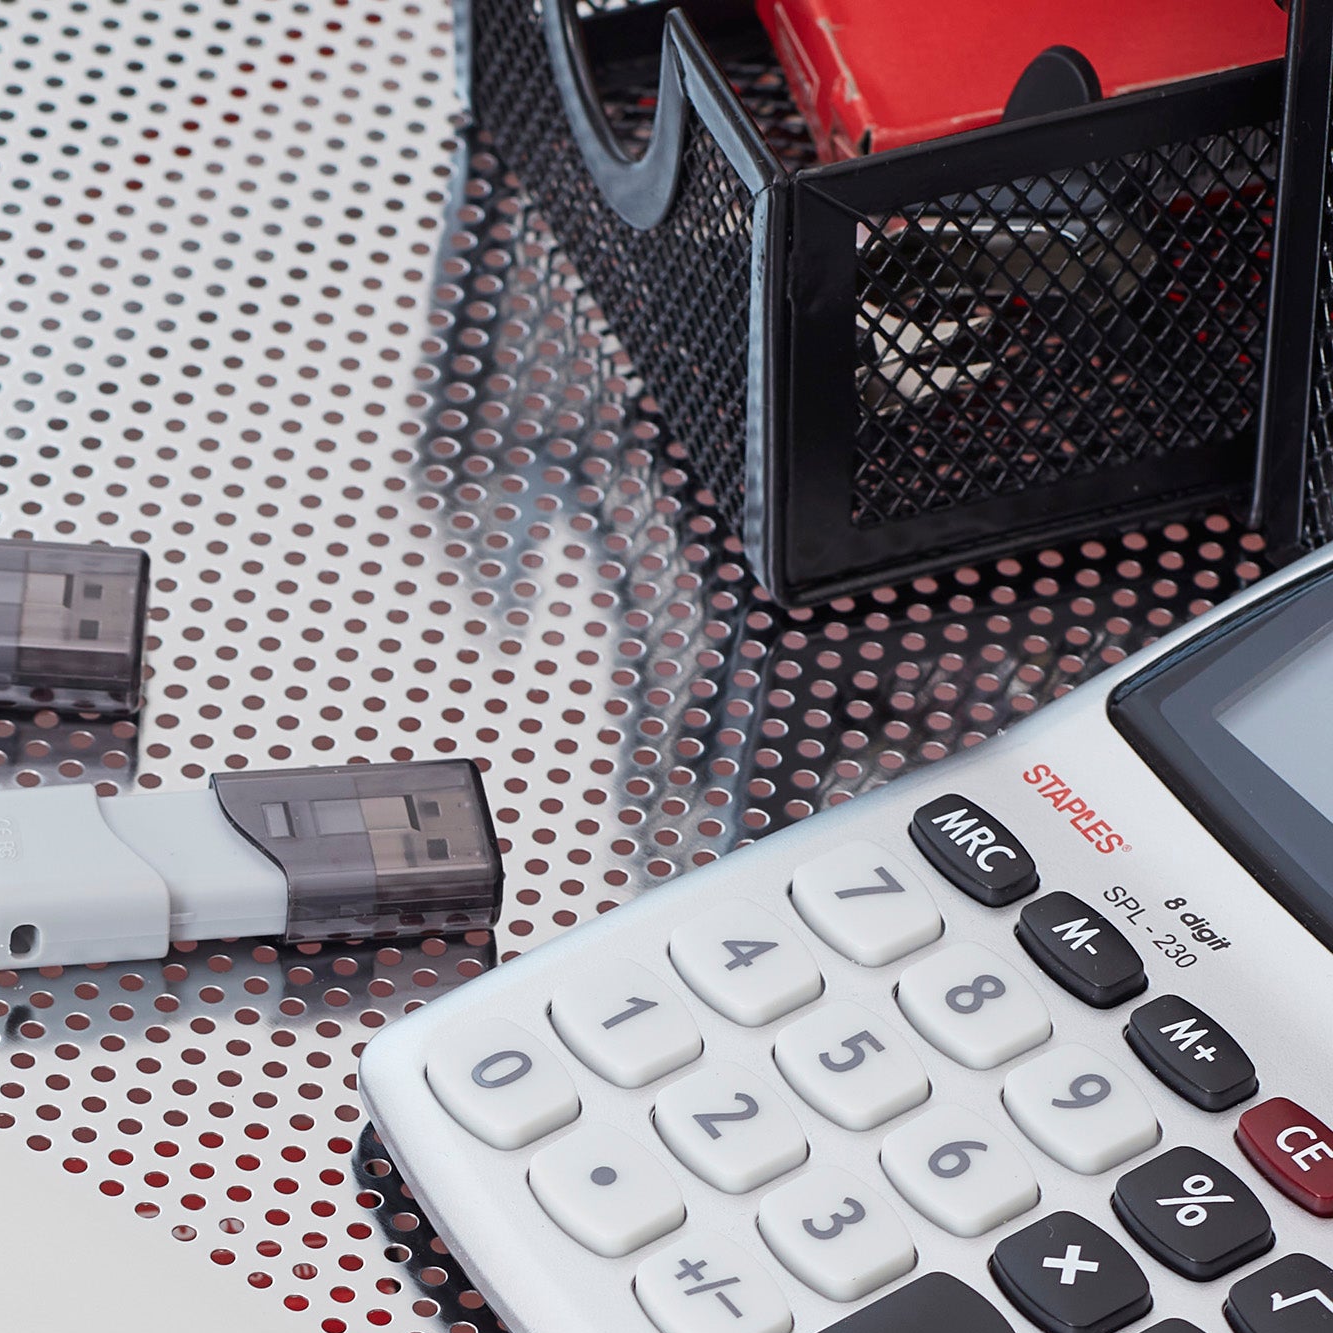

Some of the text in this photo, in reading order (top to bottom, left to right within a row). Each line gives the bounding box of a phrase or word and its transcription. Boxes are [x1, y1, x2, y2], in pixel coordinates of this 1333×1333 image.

[1023, 764, 1123, 854] STAPLES
[932, 808, 1016, 872] MRC
[835, 866, 906, 900] 7
[1052, 918, 1101, 956] M-
[1103, 885, 1139, 926] SPL
[1154, 933, 1198, 968] 230
[1164, 897, 1233, 954] 8 digit
[721, 939, 780, 972] 4
[601, 996, 659, 1031] 1
[945, 974, 1007, 1015] 8
[819, 1029, 886, 1073] 5
[1160, 1018, 1218, 1063] M+
[471, 1050, 533, 1089] 0
[1052, 1073, 1112, 1110] 9
[692, 1092, 759, 1140] 2
[928, 1140, 989, 1179] 6
[1276, 1125, 1333, 1172] CE
[802, 1197, 866, 1240] 3
[1156, 1174, 1235, 1227] %
